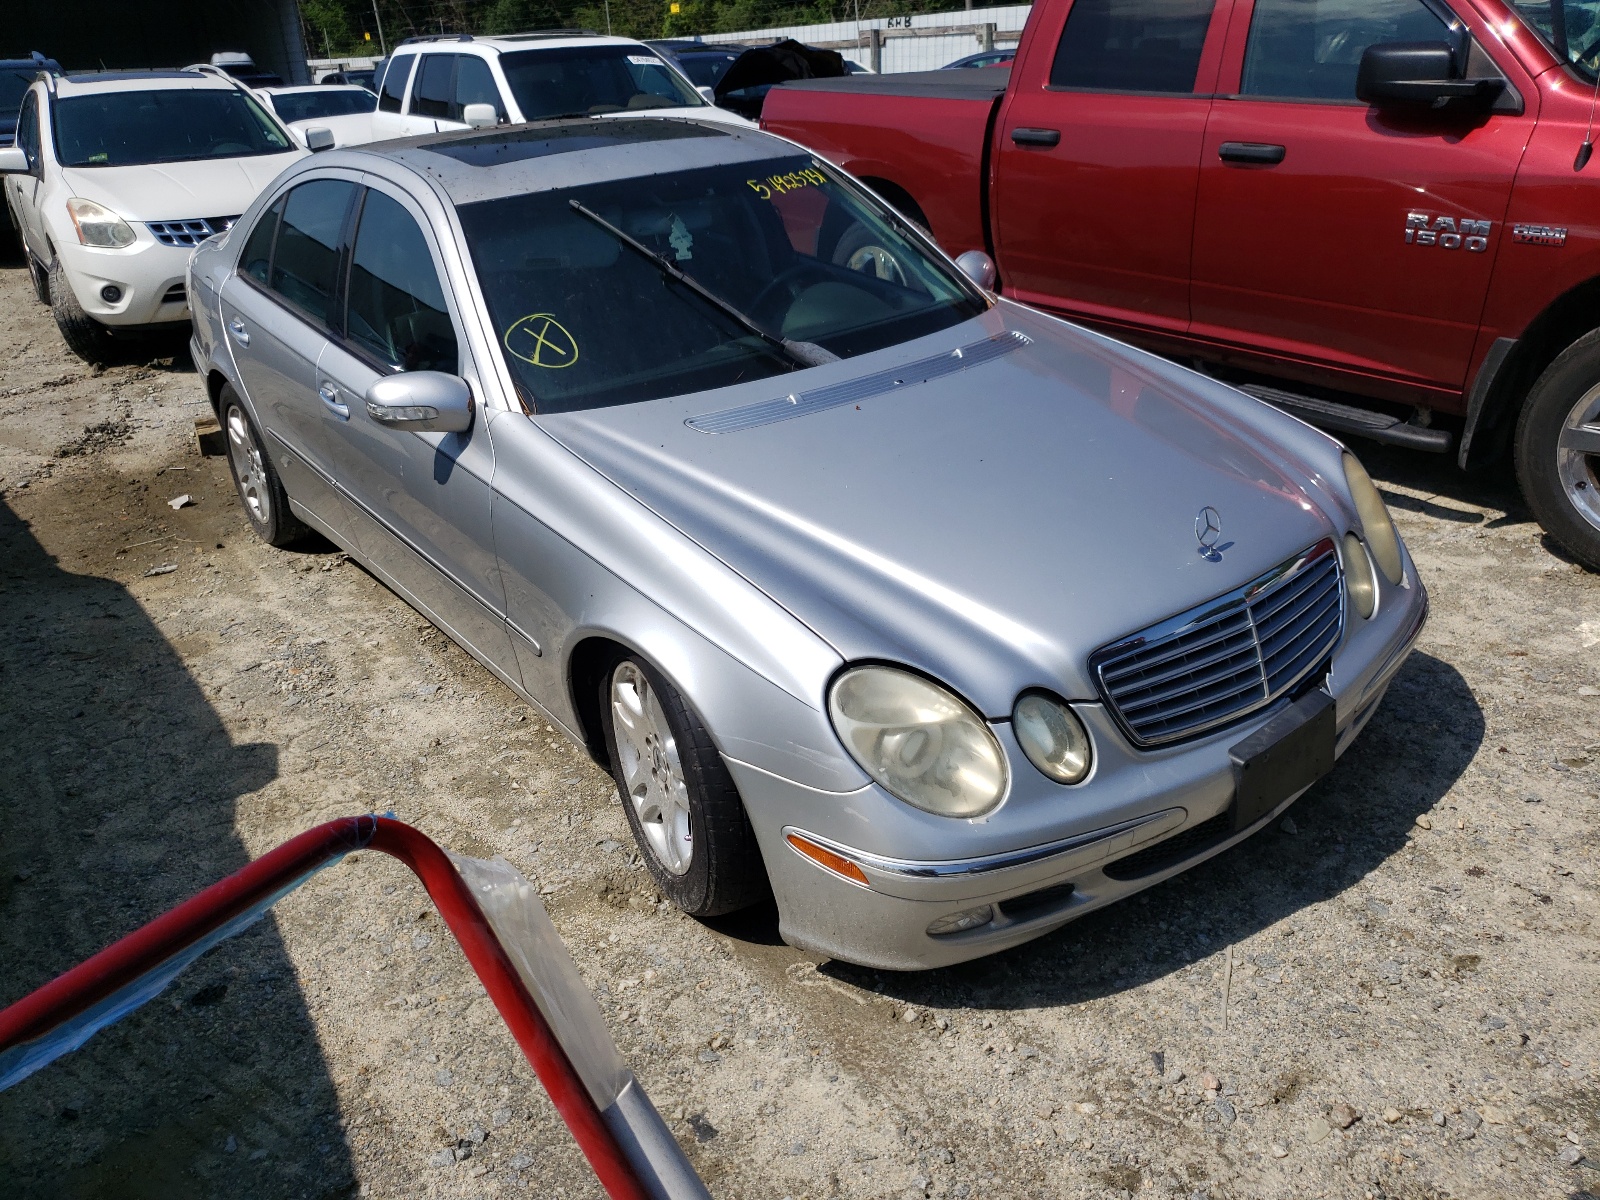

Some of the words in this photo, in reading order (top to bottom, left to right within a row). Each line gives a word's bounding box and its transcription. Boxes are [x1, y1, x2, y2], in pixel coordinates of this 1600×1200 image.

[1406, 212, 1492, 236] RAM
[1513, 224, 1568, 238] HEMI
[1405, 228, 1489, 252] 1500
